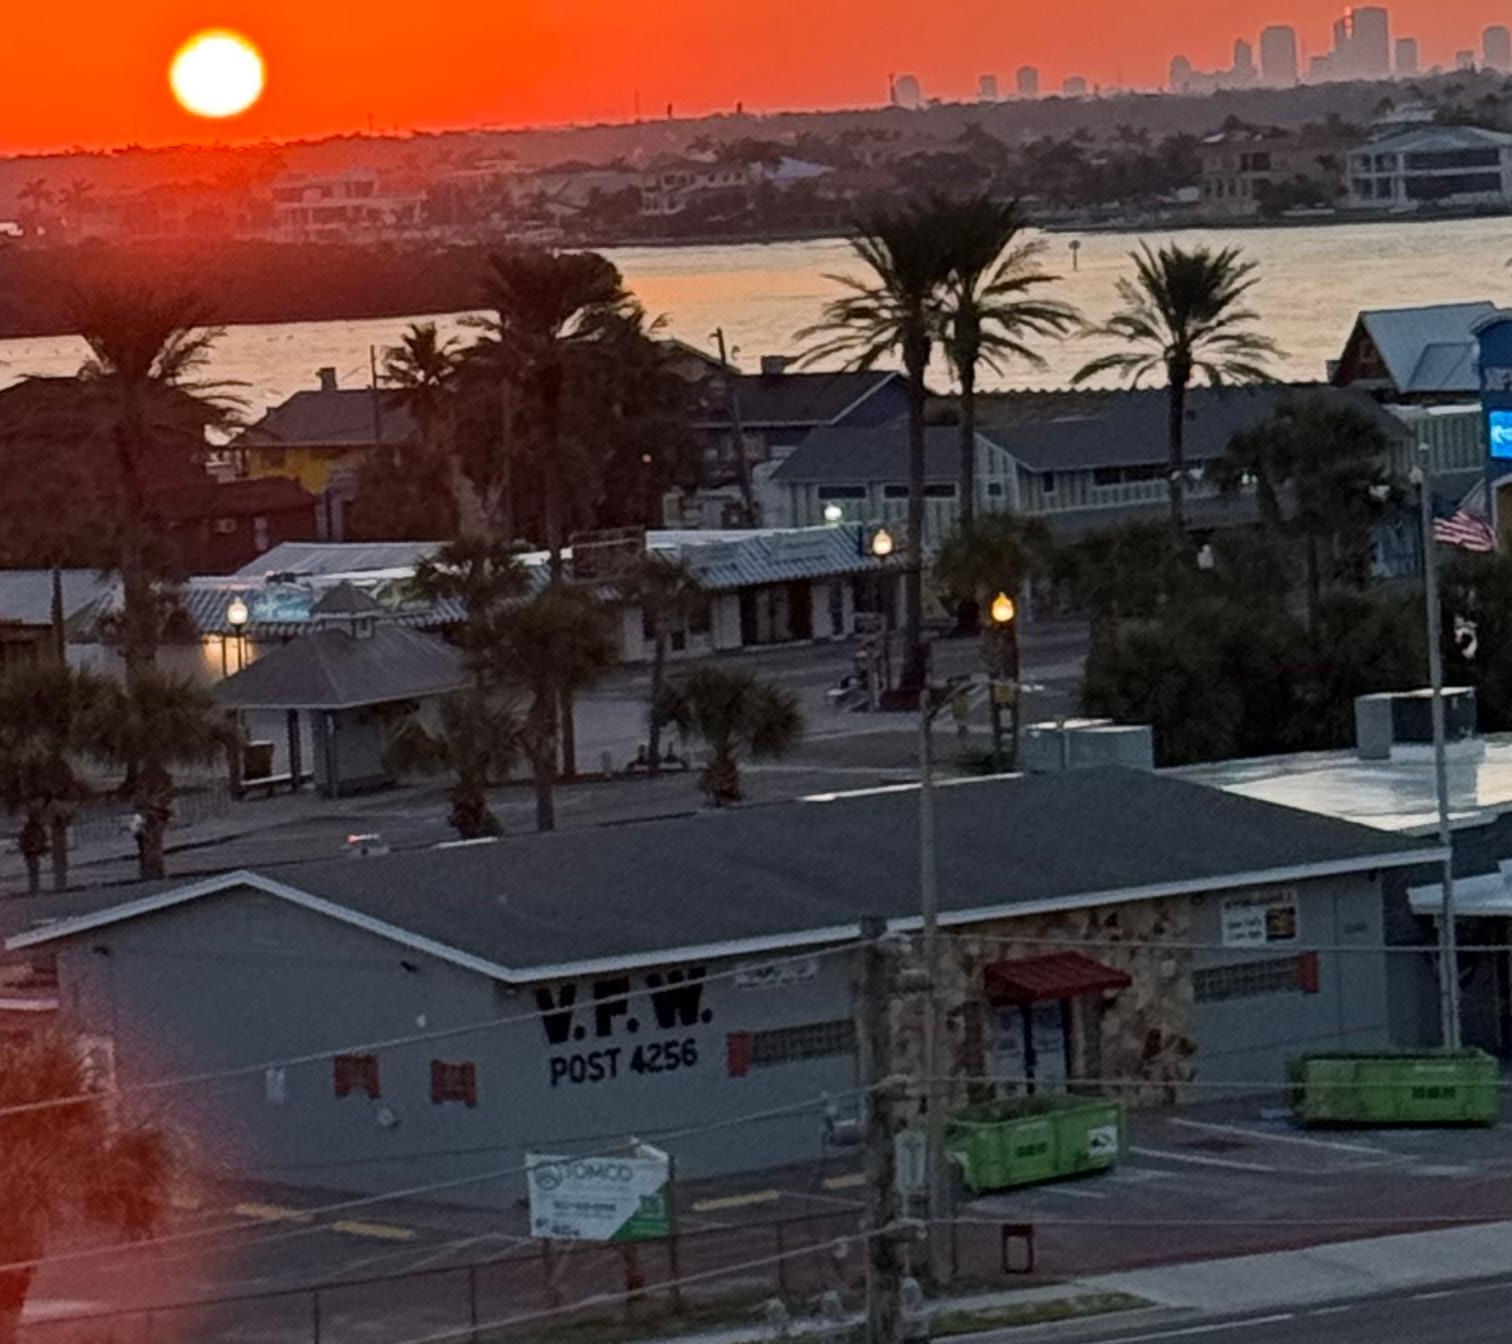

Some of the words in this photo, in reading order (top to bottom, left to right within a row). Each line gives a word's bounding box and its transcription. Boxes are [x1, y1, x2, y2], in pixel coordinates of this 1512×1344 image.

[536, 967, 713, 1044] V.F.W.
[550, 1047, 621, 1088] POST
[630, 1038, 698, 1074] 4256
